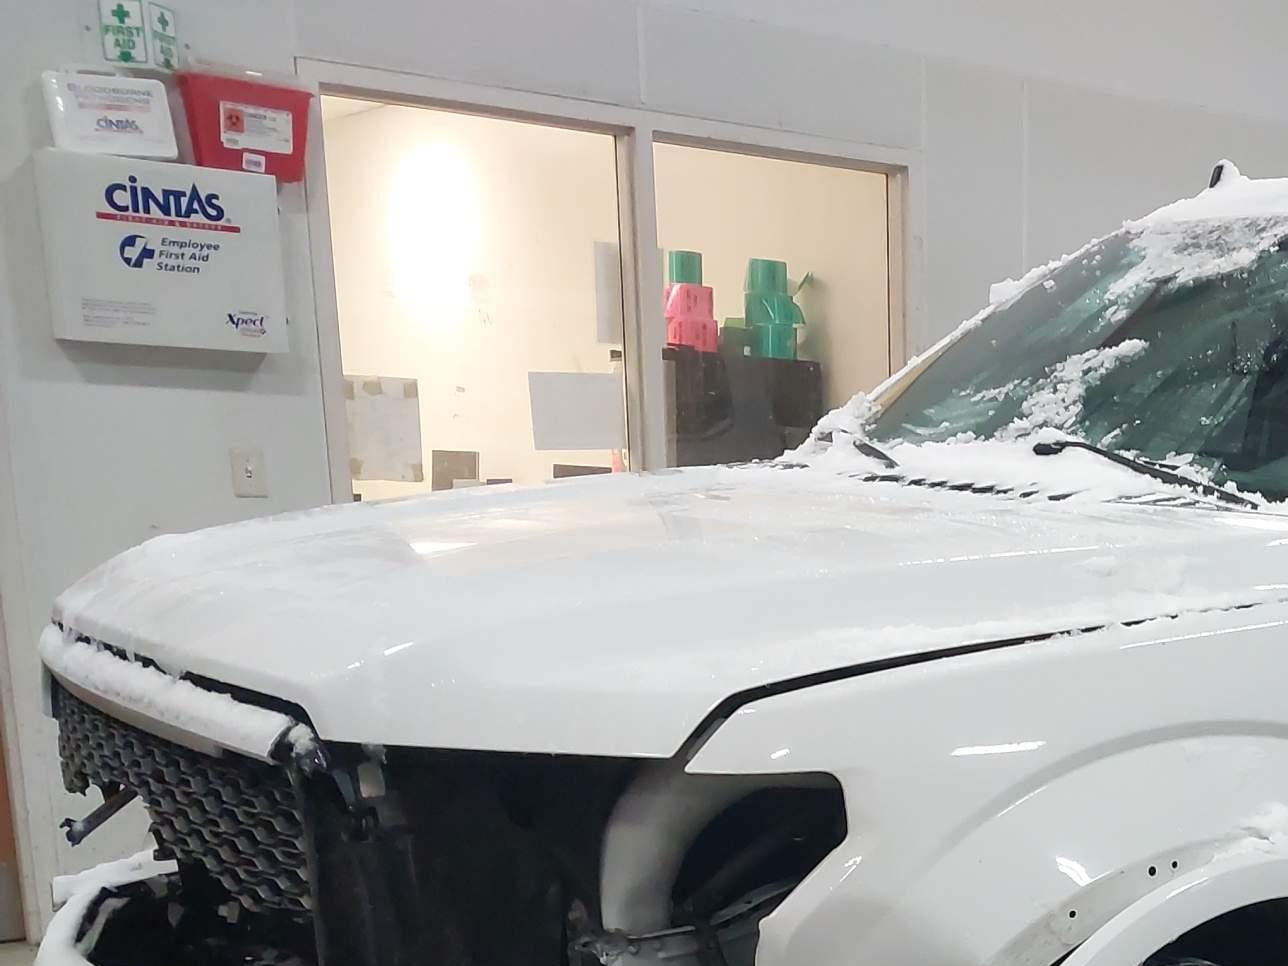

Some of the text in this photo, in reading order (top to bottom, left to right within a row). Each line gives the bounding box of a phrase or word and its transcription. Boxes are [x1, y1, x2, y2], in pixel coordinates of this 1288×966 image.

[103, 25, 142, 37] FIRST
[114, 38, 136, 50] AID
[160, 237, 220, 252] Employee
[158, 249, 210, 262] First Aid
[155, 261, 201, 274] Station
